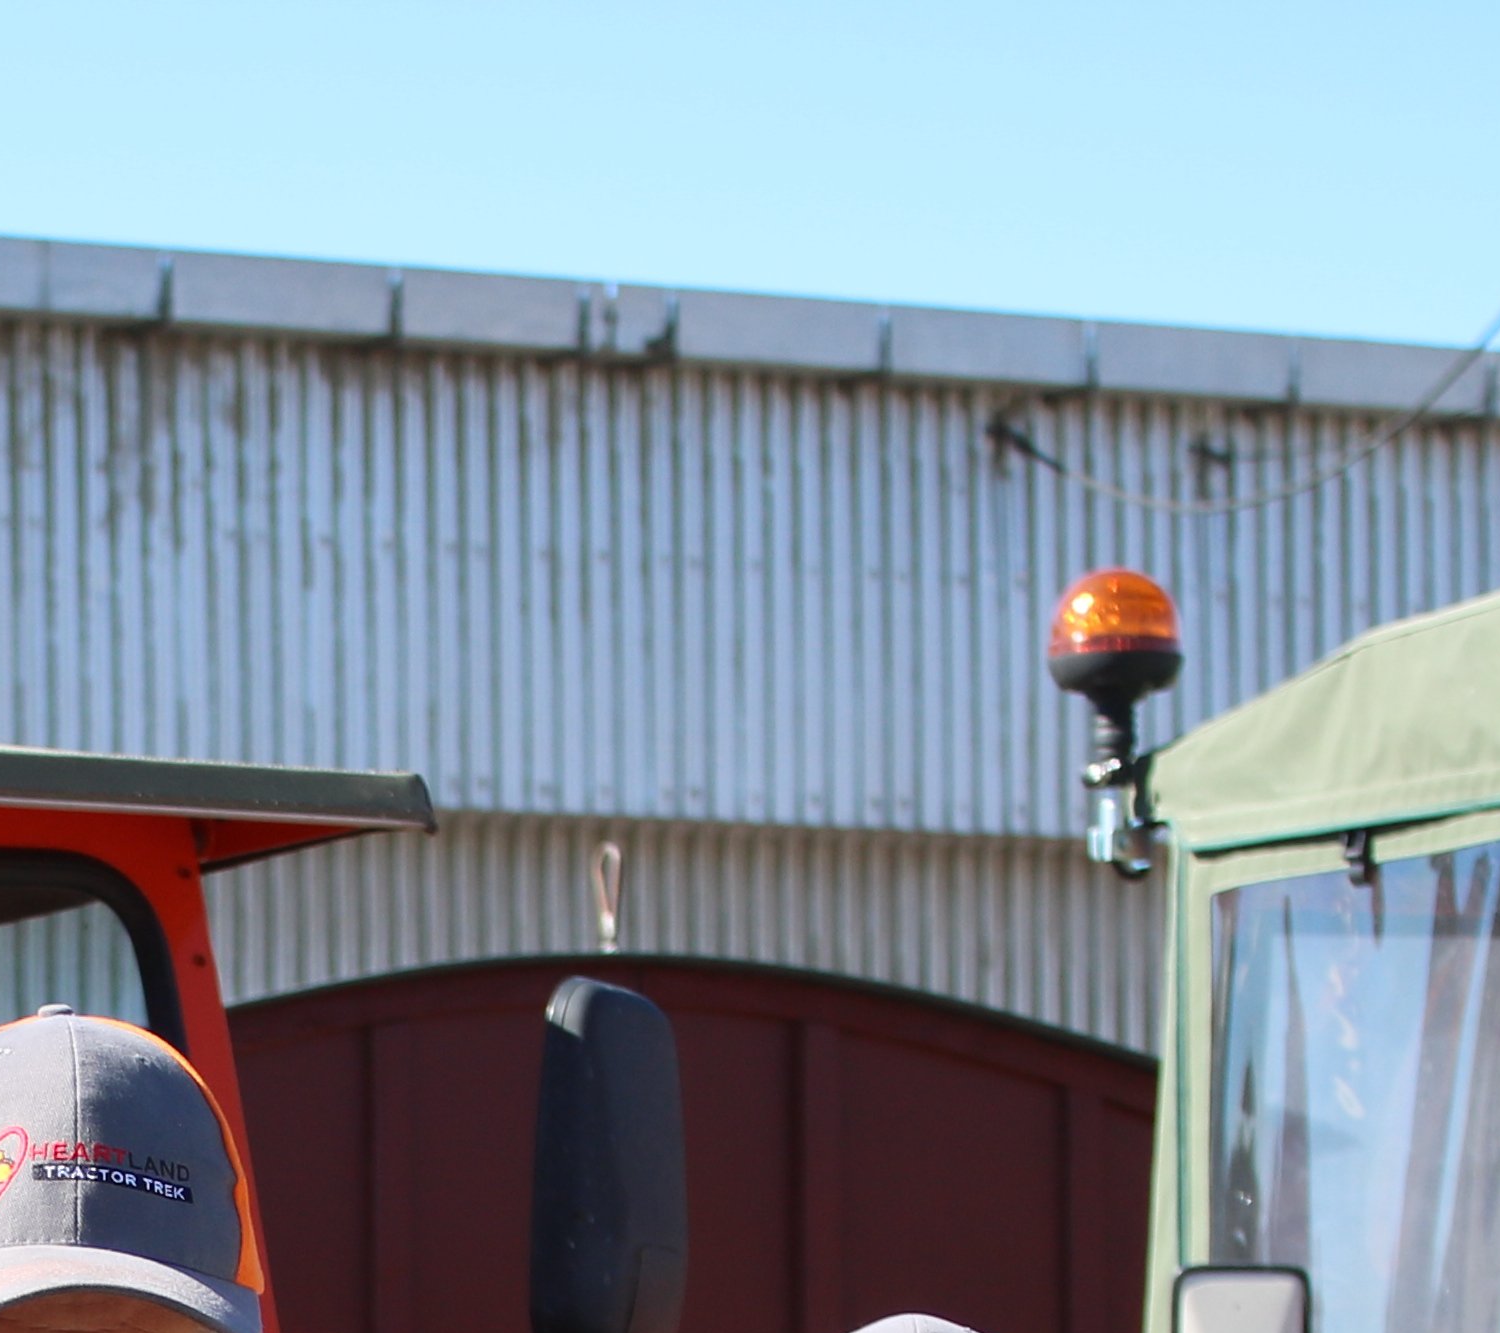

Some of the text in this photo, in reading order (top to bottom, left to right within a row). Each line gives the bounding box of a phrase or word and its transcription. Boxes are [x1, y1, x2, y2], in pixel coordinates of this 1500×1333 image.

[29, 1141, 190, 1182] HEARTLAND
[43, 1165, 186, 1201] TRACTOR TREK
